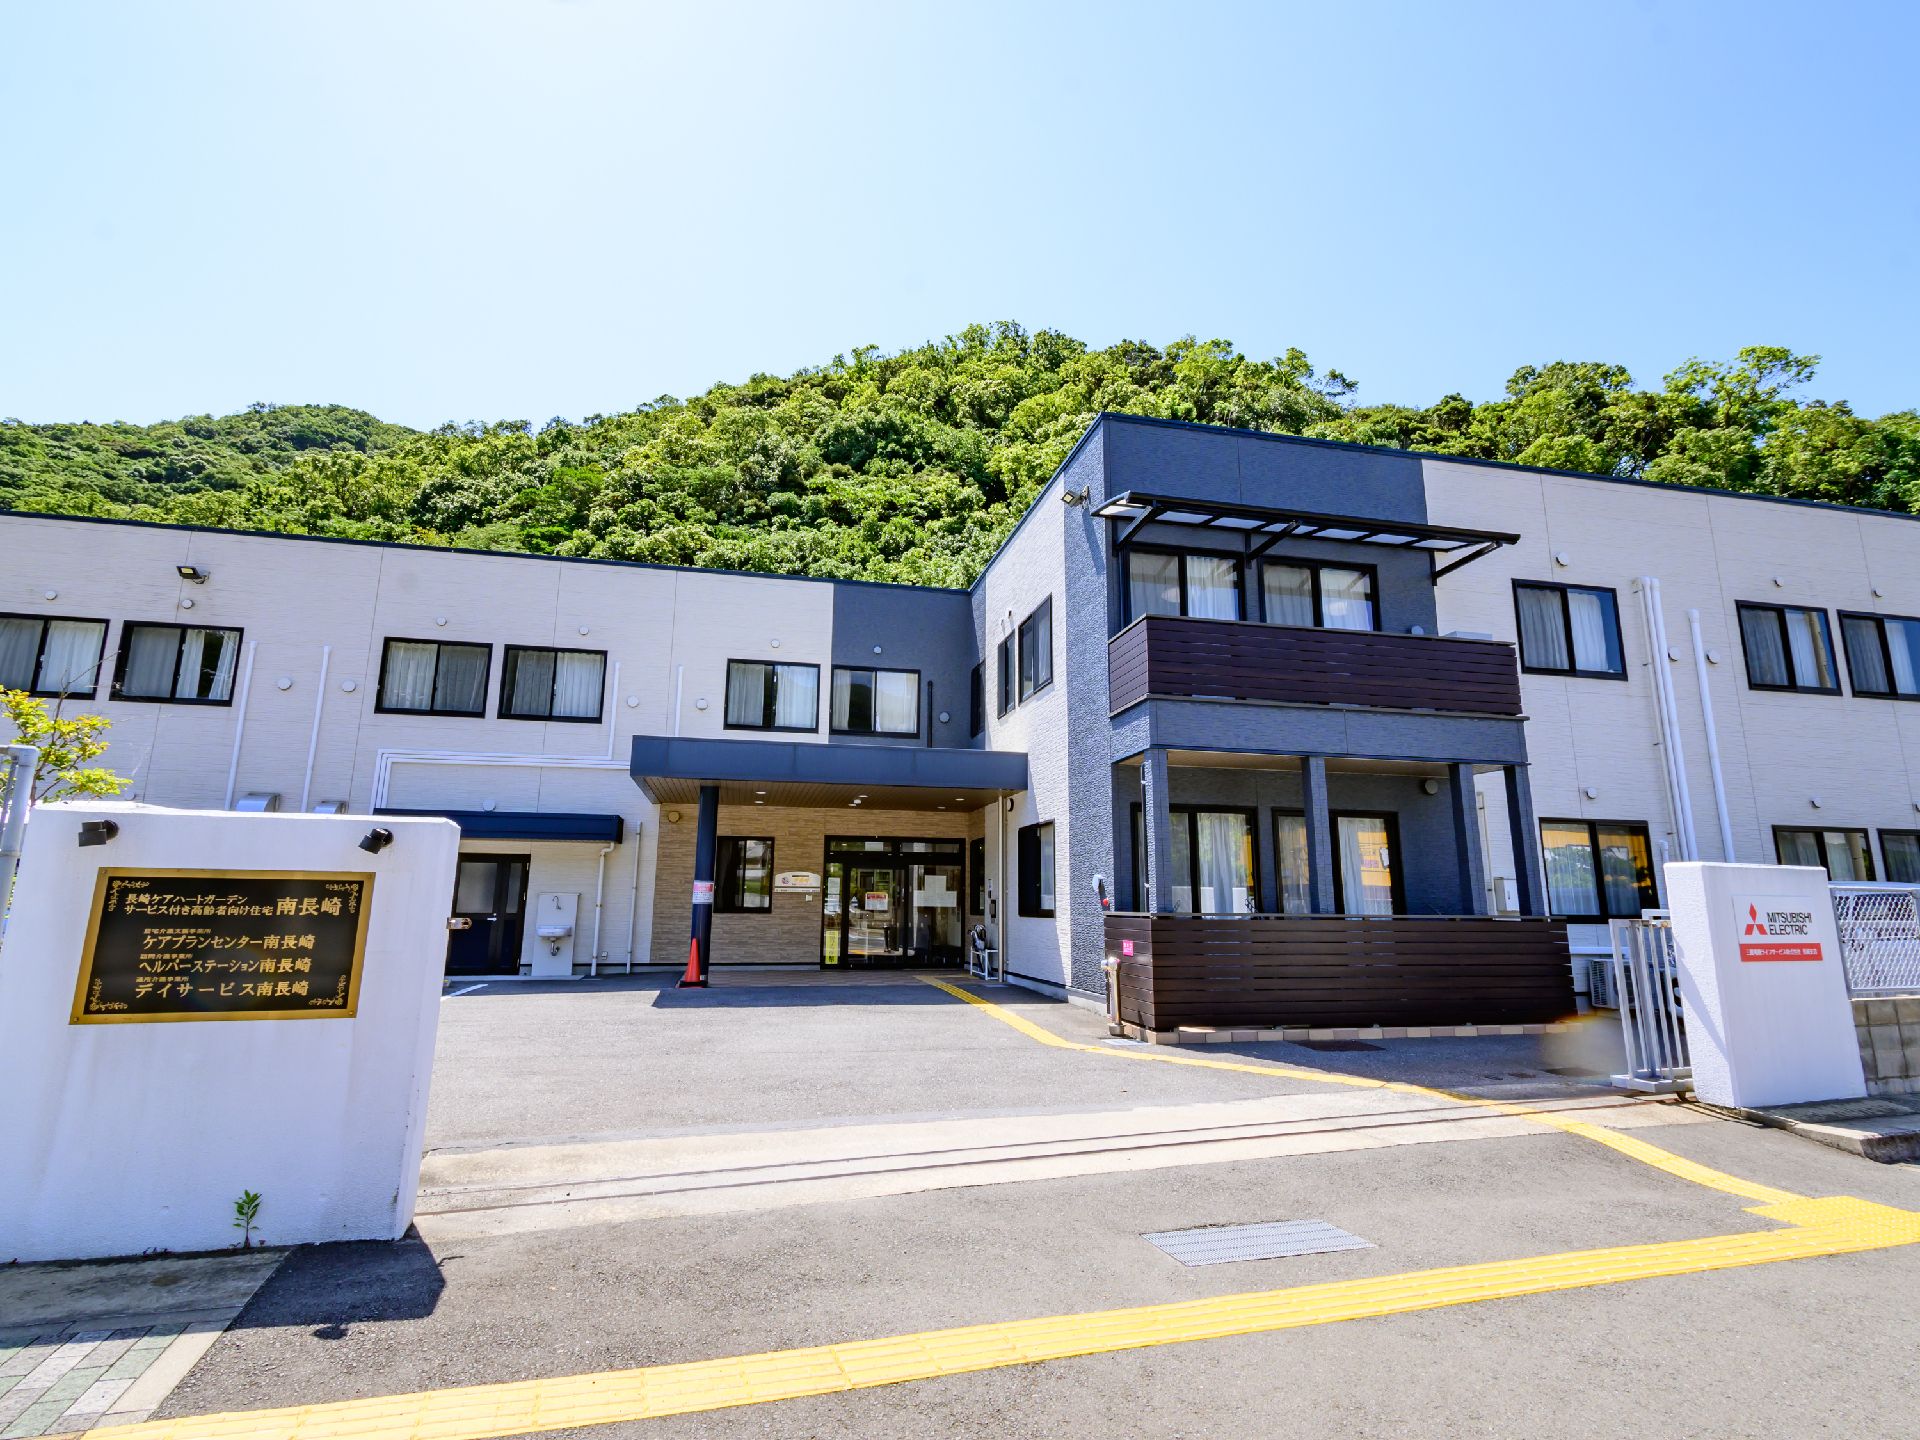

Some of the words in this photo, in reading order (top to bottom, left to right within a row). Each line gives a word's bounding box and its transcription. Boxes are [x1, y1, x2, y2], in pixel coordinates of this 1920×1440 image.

[125, 893, 248, 904] 長崎ケアハートガーデン
[124, 904, 274, 916] サービス付き高齢者向け住宅
[276, 896, 342, 916] 南長崎
[1766, 912, 1812, 923] MITSUBISHI
[1769, 924, 1808, 935] ELECTRIC
[142, 934, 316, 950] ケアプランセンター南長崎
[139, 957, 312, 973] ヘルパーステーション南長崎
[135, 980, 309, 999] デイサービス南長崎
